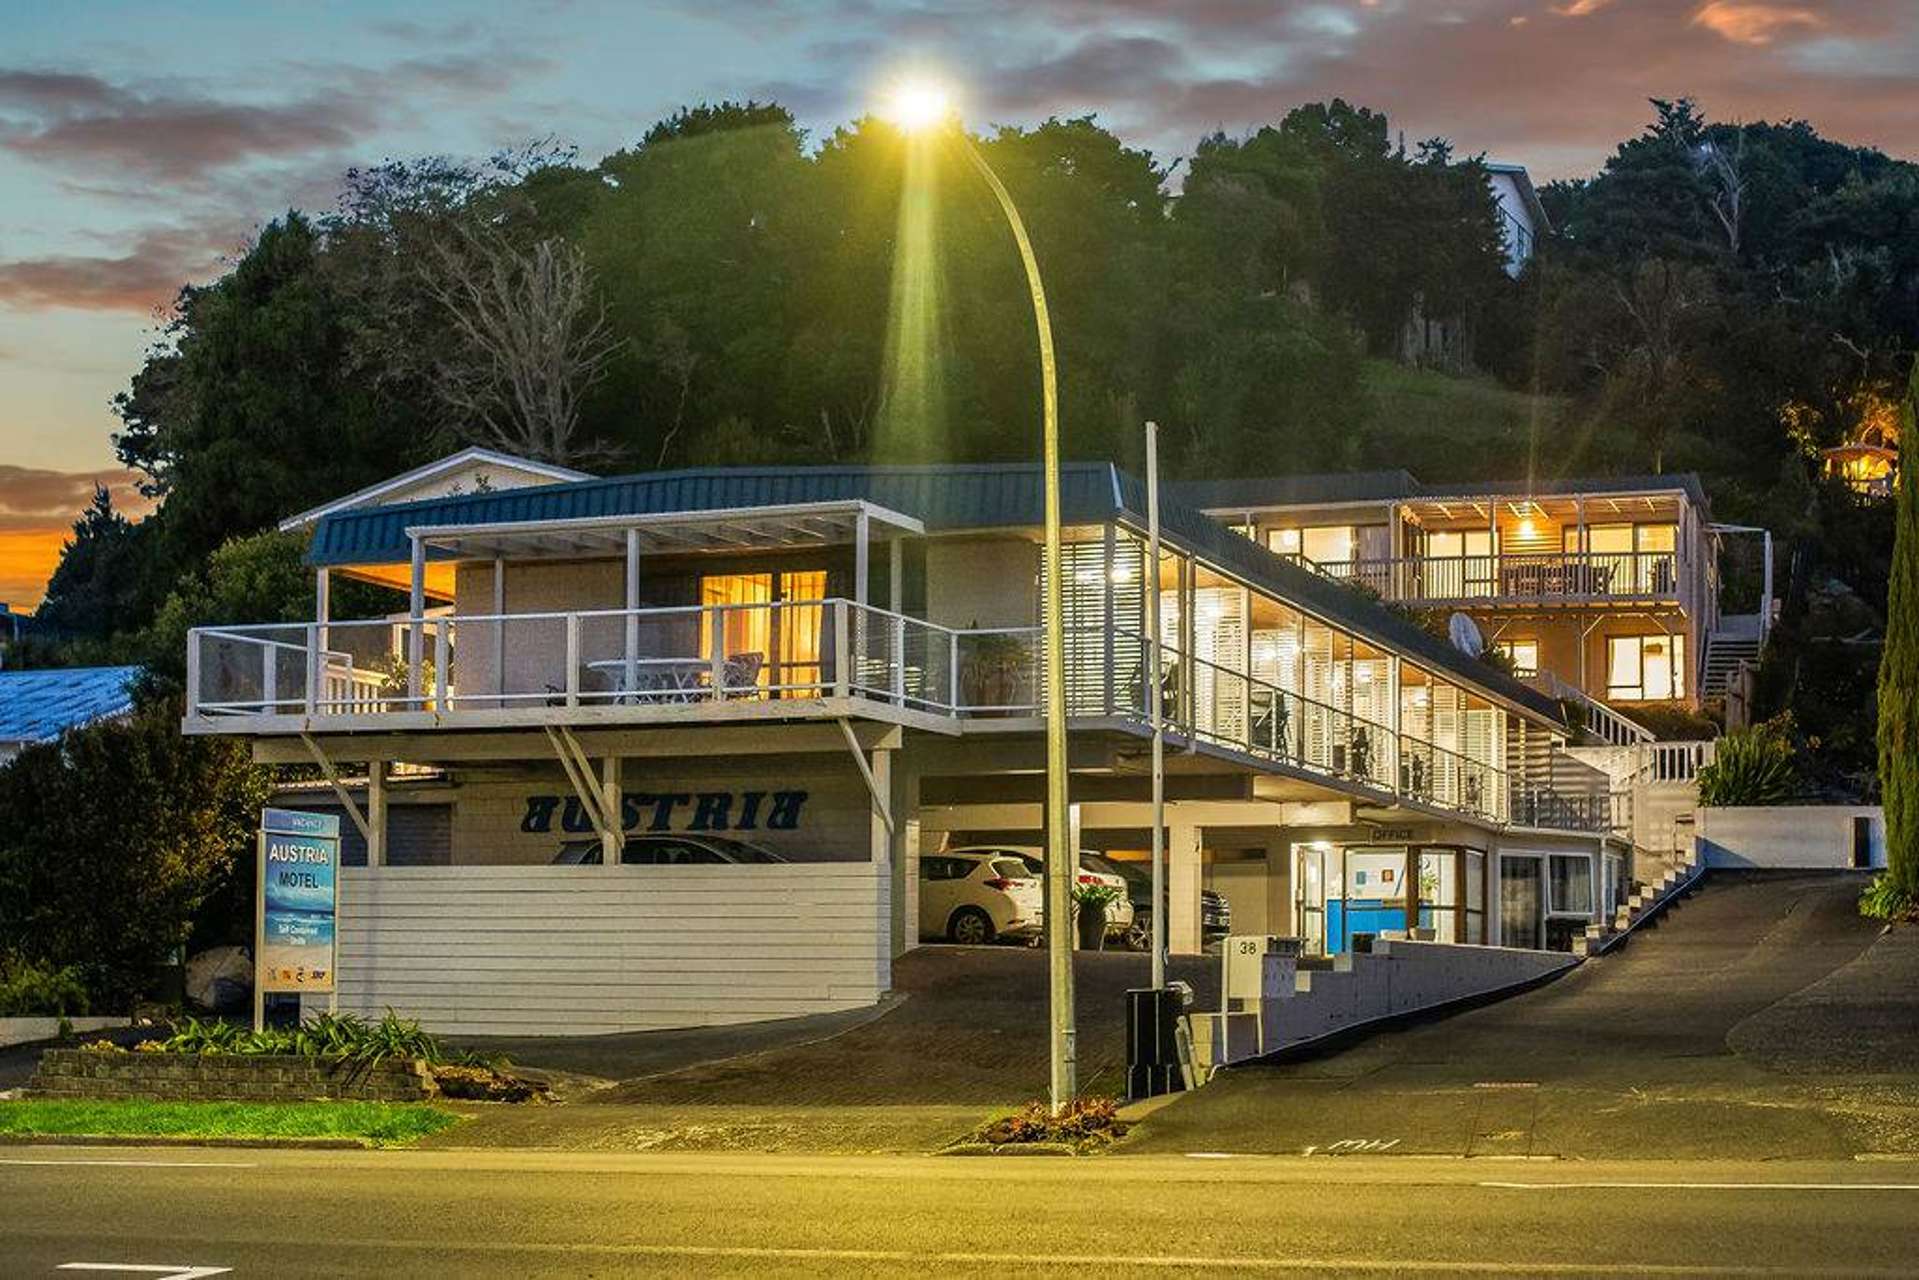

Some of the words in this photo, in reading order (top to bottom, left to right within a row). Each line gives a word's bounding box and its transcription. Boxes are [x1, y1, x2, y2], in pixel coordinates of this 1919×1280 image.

[1373, 829, 1412, 840] OFFICE
[269, 843, 328, 864] AUSTRIA
[279, 871, 319, 889] MOTEL
[1240, 942, 1256, 955] 38
